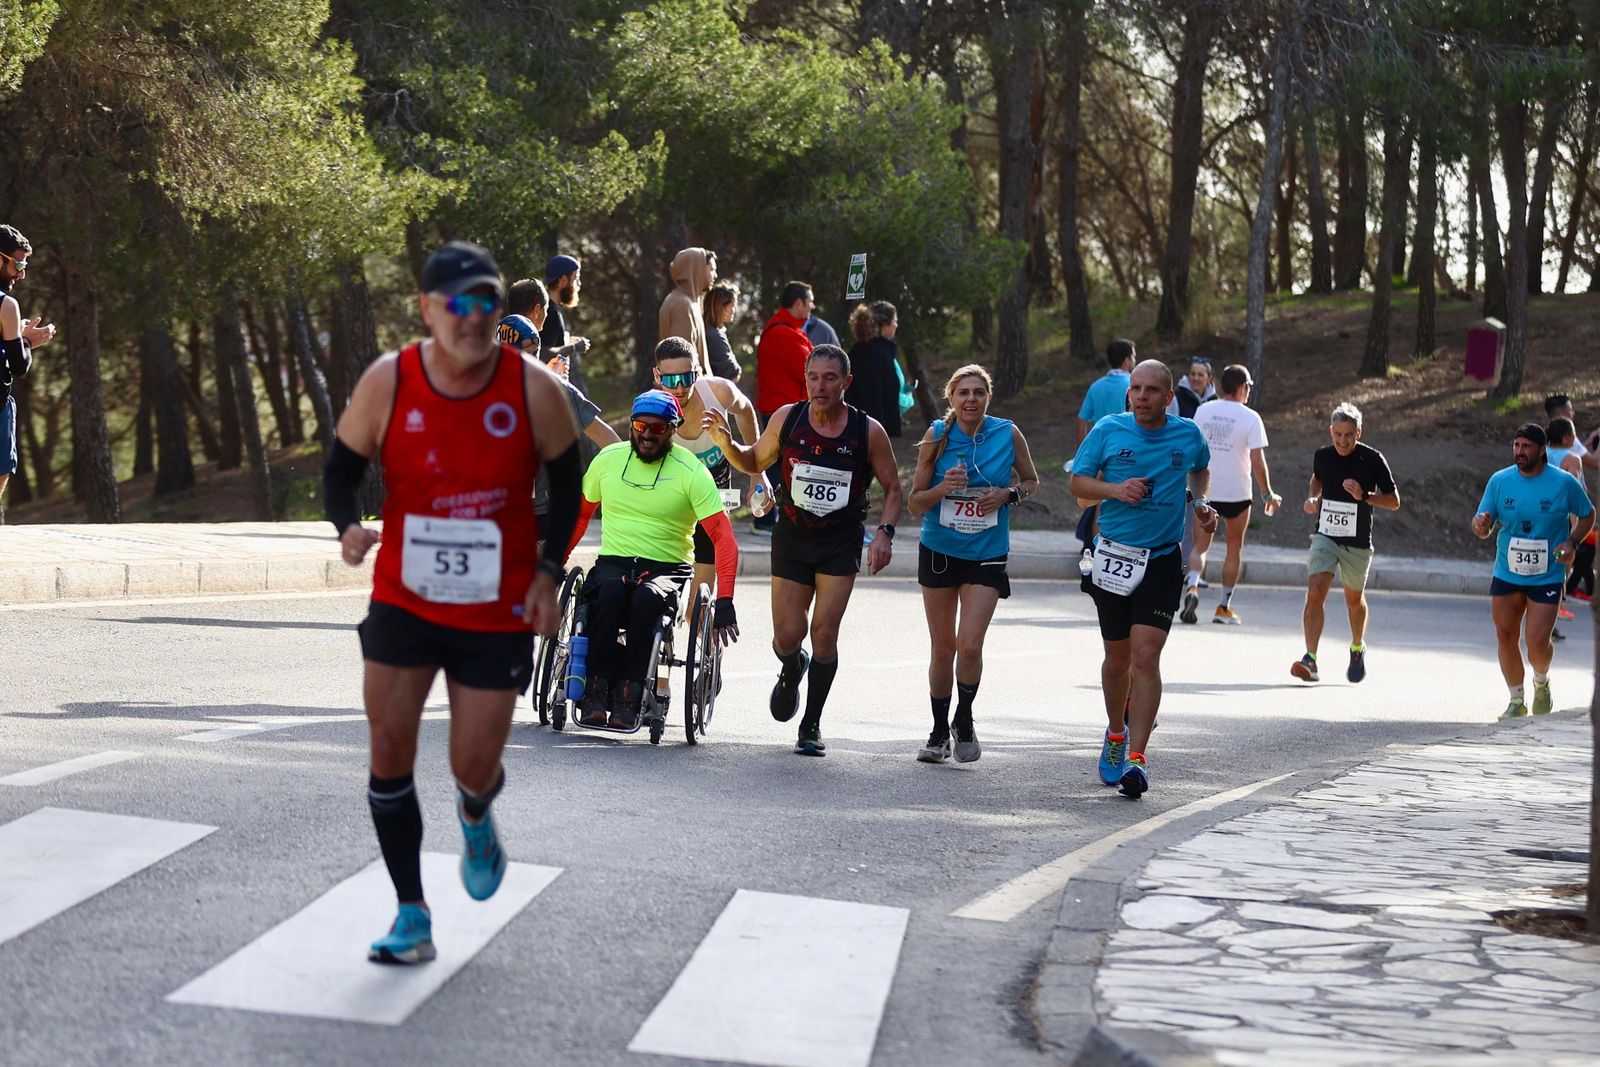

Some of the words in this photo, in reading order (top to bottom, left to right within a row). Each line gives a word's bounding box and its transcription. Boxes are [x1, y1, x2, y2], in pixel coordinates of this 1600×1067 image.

[804, 484, 837, 502] 486
[954, 501, 986, 518] 786
[1326, 514, 1349, 526] 456
[434, 551, 469, 576] 53
[1516, 552, 1540, 565] 343
[1101, 558, 1134, 579] 123
